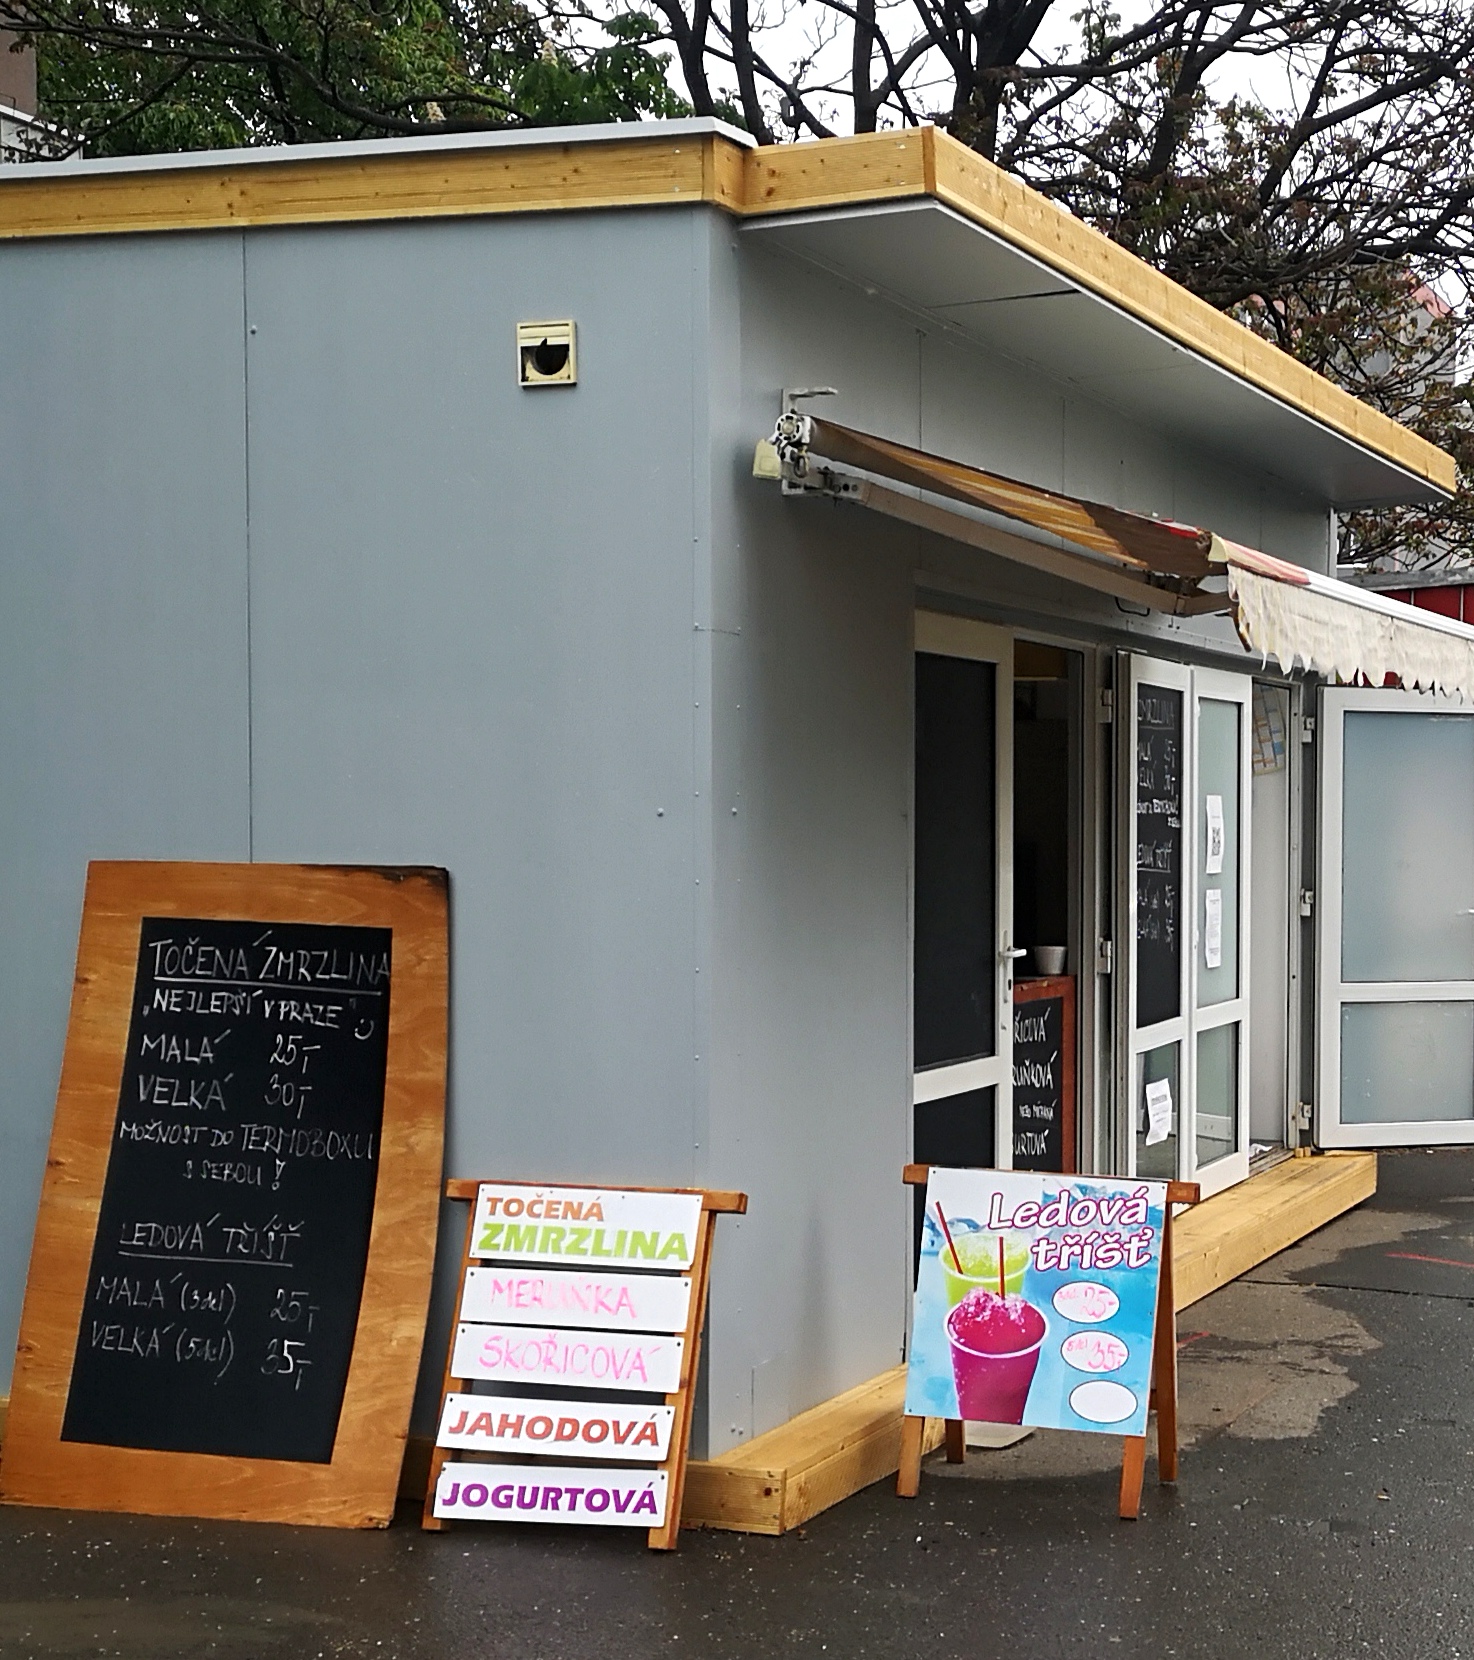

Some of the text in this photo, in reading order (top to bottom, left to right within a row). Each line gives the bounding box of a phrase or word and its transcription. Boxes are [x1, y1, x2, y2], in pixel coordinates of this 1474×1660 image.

[149, 930, 391, 986] TOČENÁ ZMRZLINA
[1014, 1006, 1051, 1043] ŘICOVÁ
[140, 1029, 231, 1064] MALÁ
[138, 1073, 234, 1112] VELKÁ
[119, 1119, 207, 1145] MOŽNOST
[210, 1128, 234, 1148] DO
[1013, 1129, 1049, 1156] URTOVÁ
[486, 1192, 605, 1222] TOČENÁ
[988, 1186, 1150, 1230] Ledová
[119, 1212, 222, 1252] LEDOVÁ
[477, 1222, 690, 1262] ZMRZLINA
[1031, 1228, 1155, 1272] tříšť
[95, 1272, 183, 1310] MALÁ
[91, 1320, 175, 1357] VELKÁ
[478, 1332, 663, 1384] SKOŘICOVÁ
[448, 1411, 660, 1446] JAHODOVÁ
[441, 1481, 658, 1515] JOGURTOVÁ
